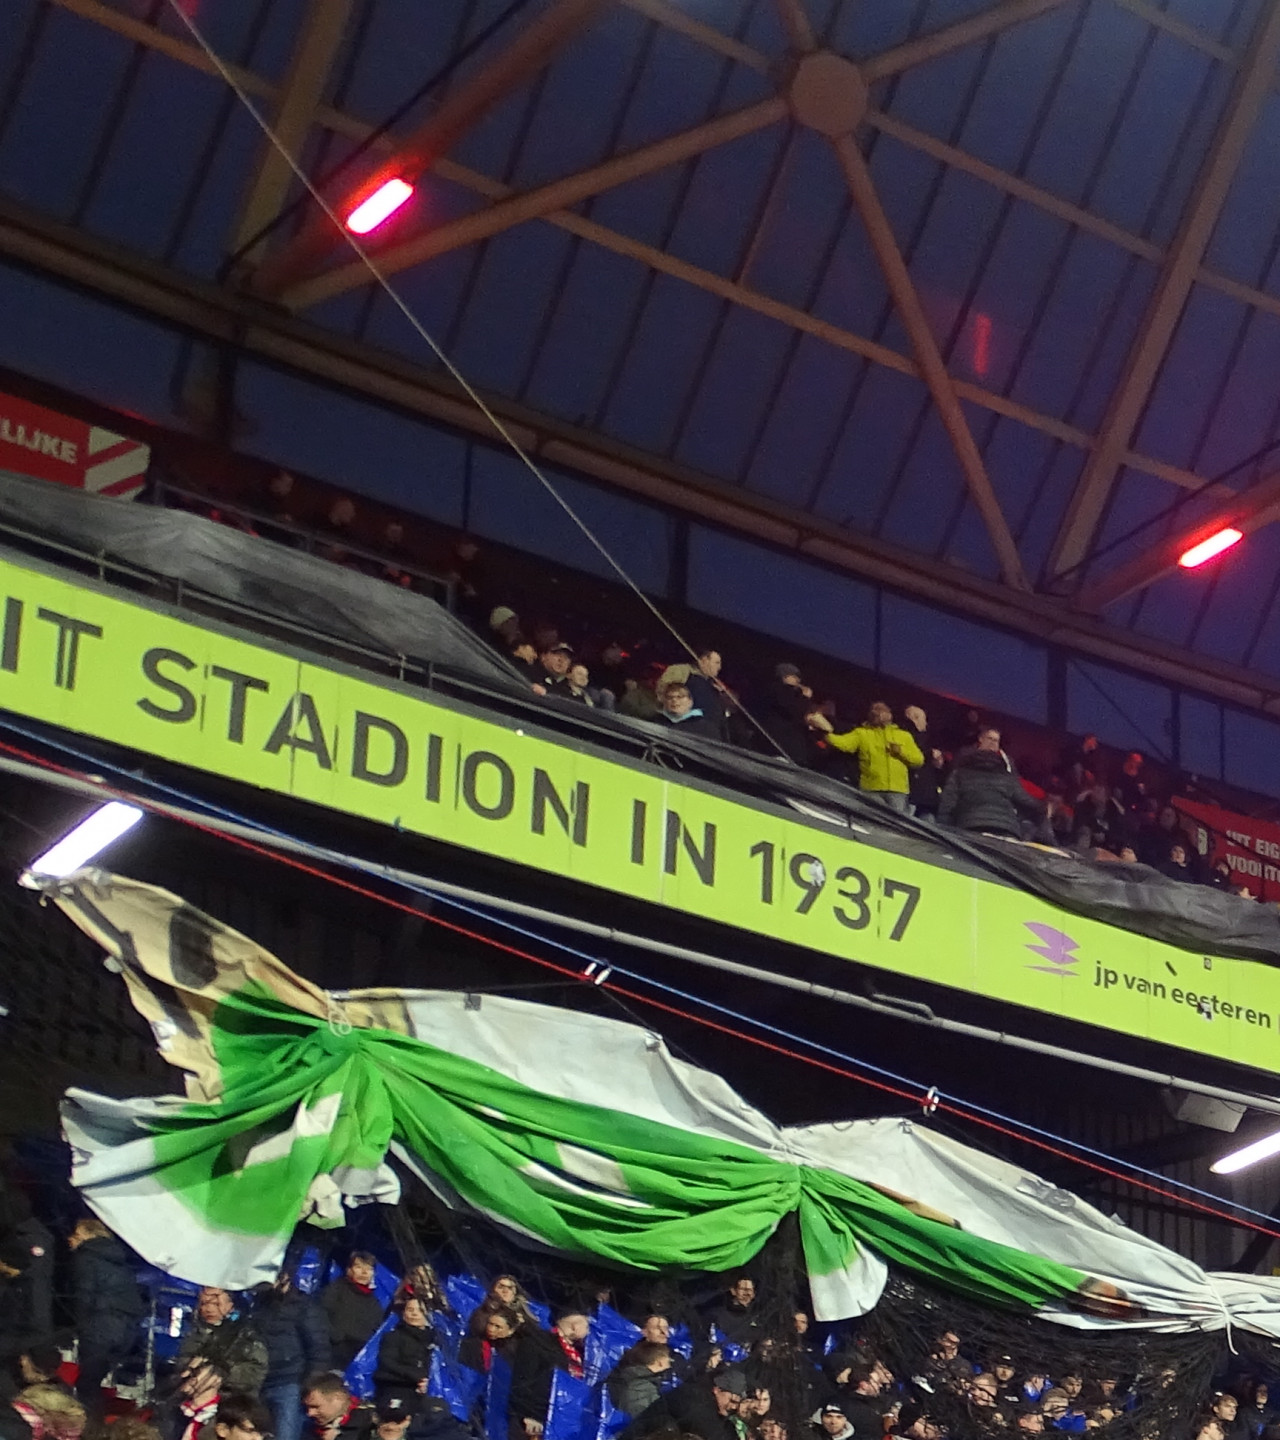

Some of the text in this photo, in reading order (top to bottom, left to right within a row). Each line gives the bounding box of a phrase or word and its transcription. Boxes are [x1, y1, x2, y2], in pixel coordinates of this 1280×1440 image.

[136, 647, 590, 847] STADION
[630, 798, 717, 887] IN
[750, 839, 921, 943] 1937
[1093, 960, 1118, 987] jp
[1123, 975, 1166, 1000] van
[1171, 987, 1272, 1029] eesteren
